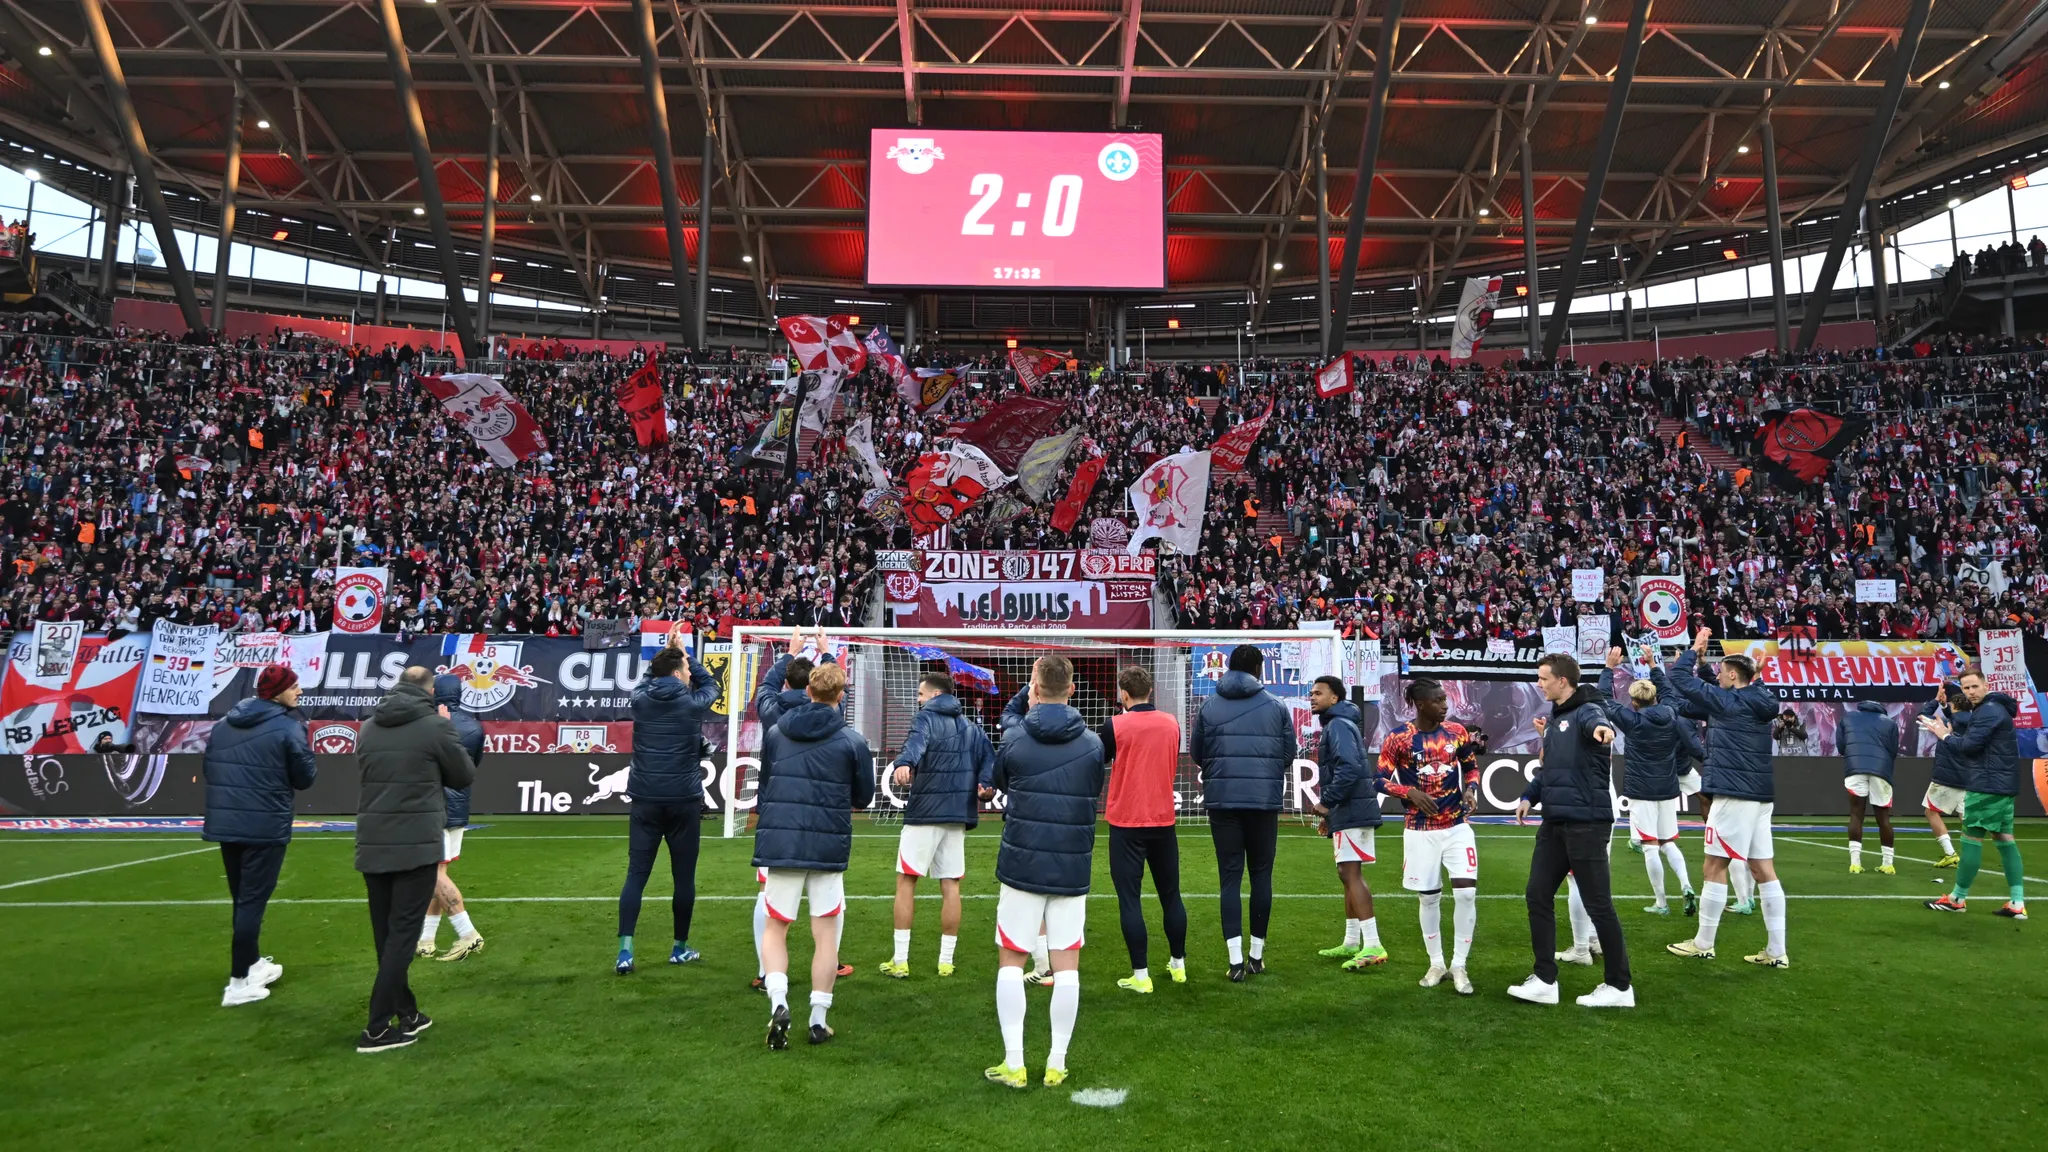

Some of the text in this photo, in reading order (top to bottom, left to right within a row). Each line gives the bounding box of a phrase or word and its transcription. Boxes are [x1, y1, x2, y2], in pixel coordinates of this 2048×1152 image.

[993, 267, 1041, 279] 17:32
[875, 552, 908, 561] ZONE
[925, 553, 999, 579] ZONE
[1032, 553, 1076, 579] 147
[1118, 555, 1155, 572] FRP
[367, 578, 378, 587] IST
[1648, 582, 1667, 590] BALL
[1668, 584, 1680, 594] IST
[1003, 593, 1071, 621] BULLS
[347, 619, 376, 630] LEIPZIG
[587, 619, 618, 630] Yussuf
[1582, 616, 1609, 627] XAVI
[47, 626, 72, 640] 20
[1658, 625, 1682, 636] EIPZIG
[1987, 630, 2020, 641] BENNY
[178, 636, 208, 647] TRIKOT
[1342, 641, 1374, 651] WLI
[1583, 638, 1606, 656] 20
[1261, 647, 1281, 657] ANS
[1993, 646, 2014, 663] 39
[168, 656, 190, 671] 39
[1348, 661, 1376, 671] BTE
[153, 668, 200, 687] BENNY
[324, 651, 651, 692] LLS CLU
[1344, 677, 1356, 685] DEI
[142, 684, 204, 706] HENRICHS
[297, 696, 344, 706] GEISTERUNG
[600, 698, 633, 707] RB LEIPZ
[5, 706, 121, 744] RB LEIPZIG
[316, 729, 353, 741] BULLS CLUB
[484, 734, 540, 753] ATES
[1781, 746, 1802, 754] FOTO
[24, 754, 37, 776] Red
[518, 780, 571, 811] The
[1466, 847, 1477, 867] 8
